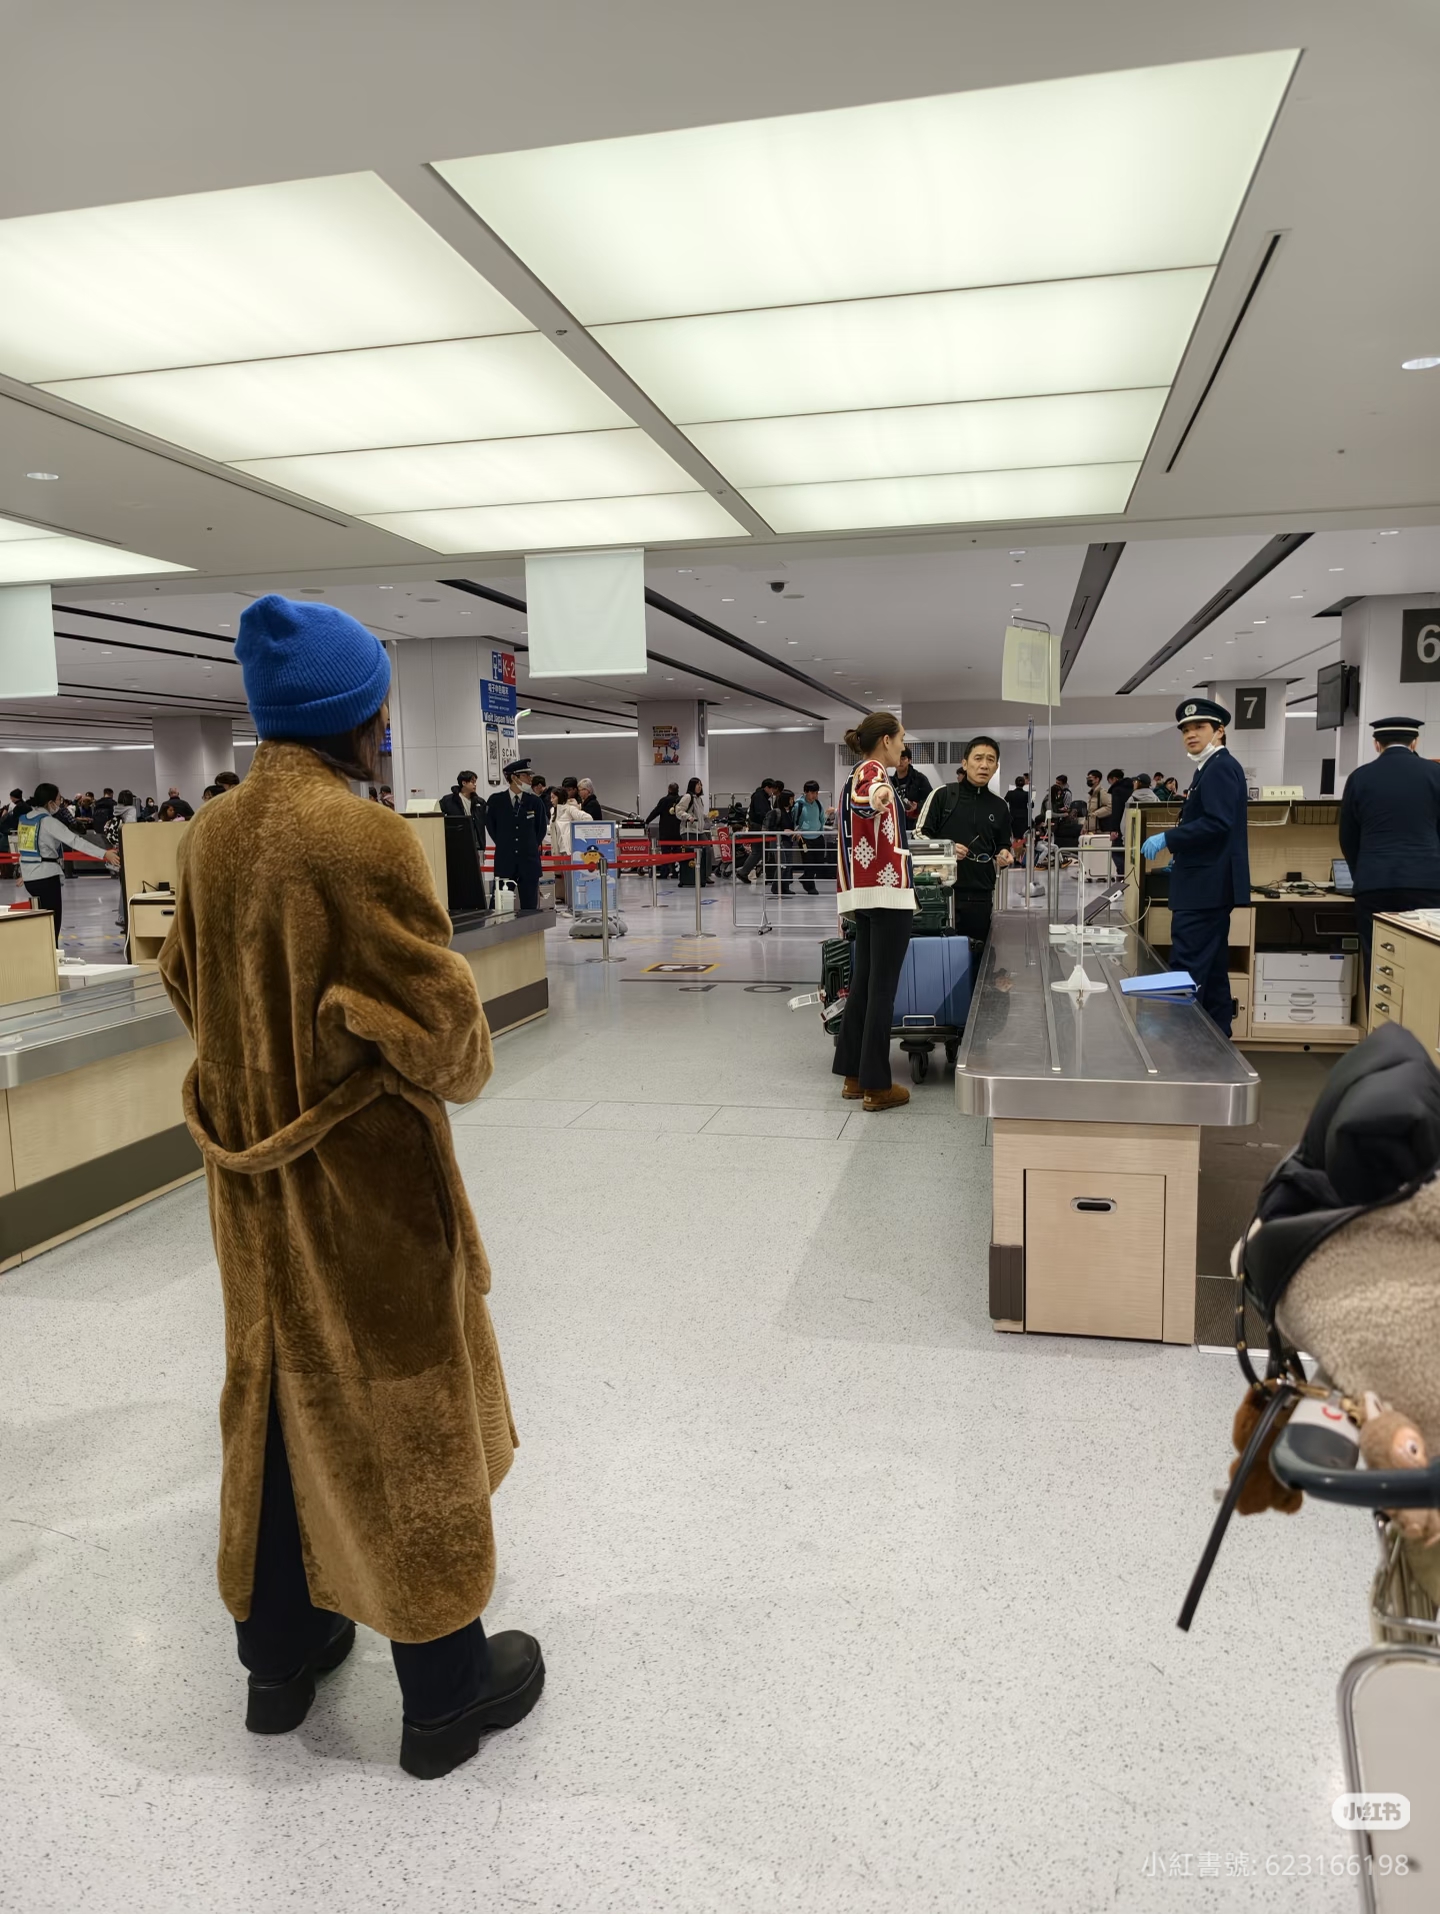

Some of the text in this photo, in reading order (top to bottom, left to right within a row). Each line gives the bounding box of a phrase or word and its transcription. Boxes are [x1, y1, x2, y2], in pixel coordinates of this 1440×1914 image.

[1416, 624, 1440, 664] 6
[1243, 696, 1258, 719] 7
[484, 712, 515, 725] Visit Japan Web
[502, 748, 517, 758] SCAN
